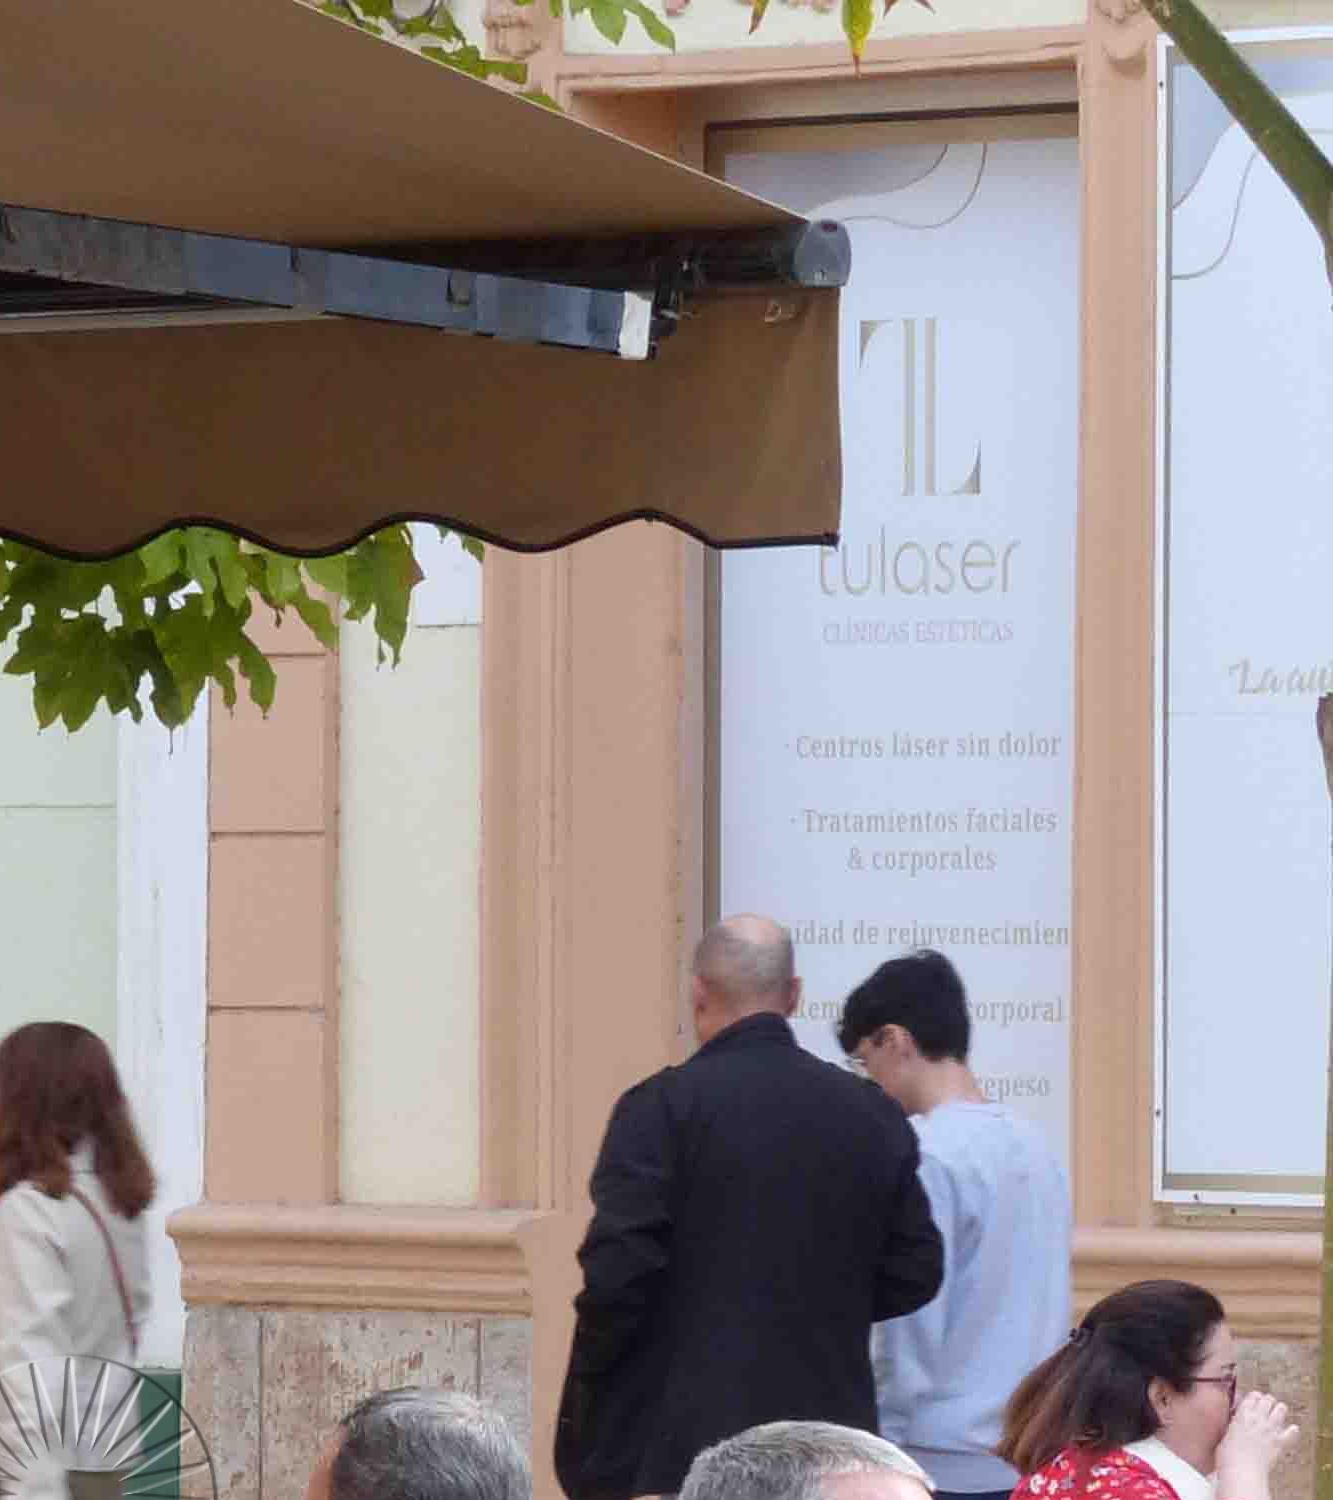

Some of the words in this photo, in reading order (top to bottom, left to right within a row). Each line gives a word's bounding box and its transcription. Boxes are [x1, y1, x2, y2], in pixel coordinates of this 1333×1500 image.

[819, 523, 1022, 597] tulaser
[796, 734, 884, 759] Centros
[957, 732, 990, 758] sin
[998, 731, 1062, 758] dolor
[803, 807, 958, 833] Tratamientos
[966, 806, 1058, 833] faciales
[872, 844, 998, 879] corporales
[852, 919, 878, 946] de
[885, 919, 1069, 952] rejuvenecimien
